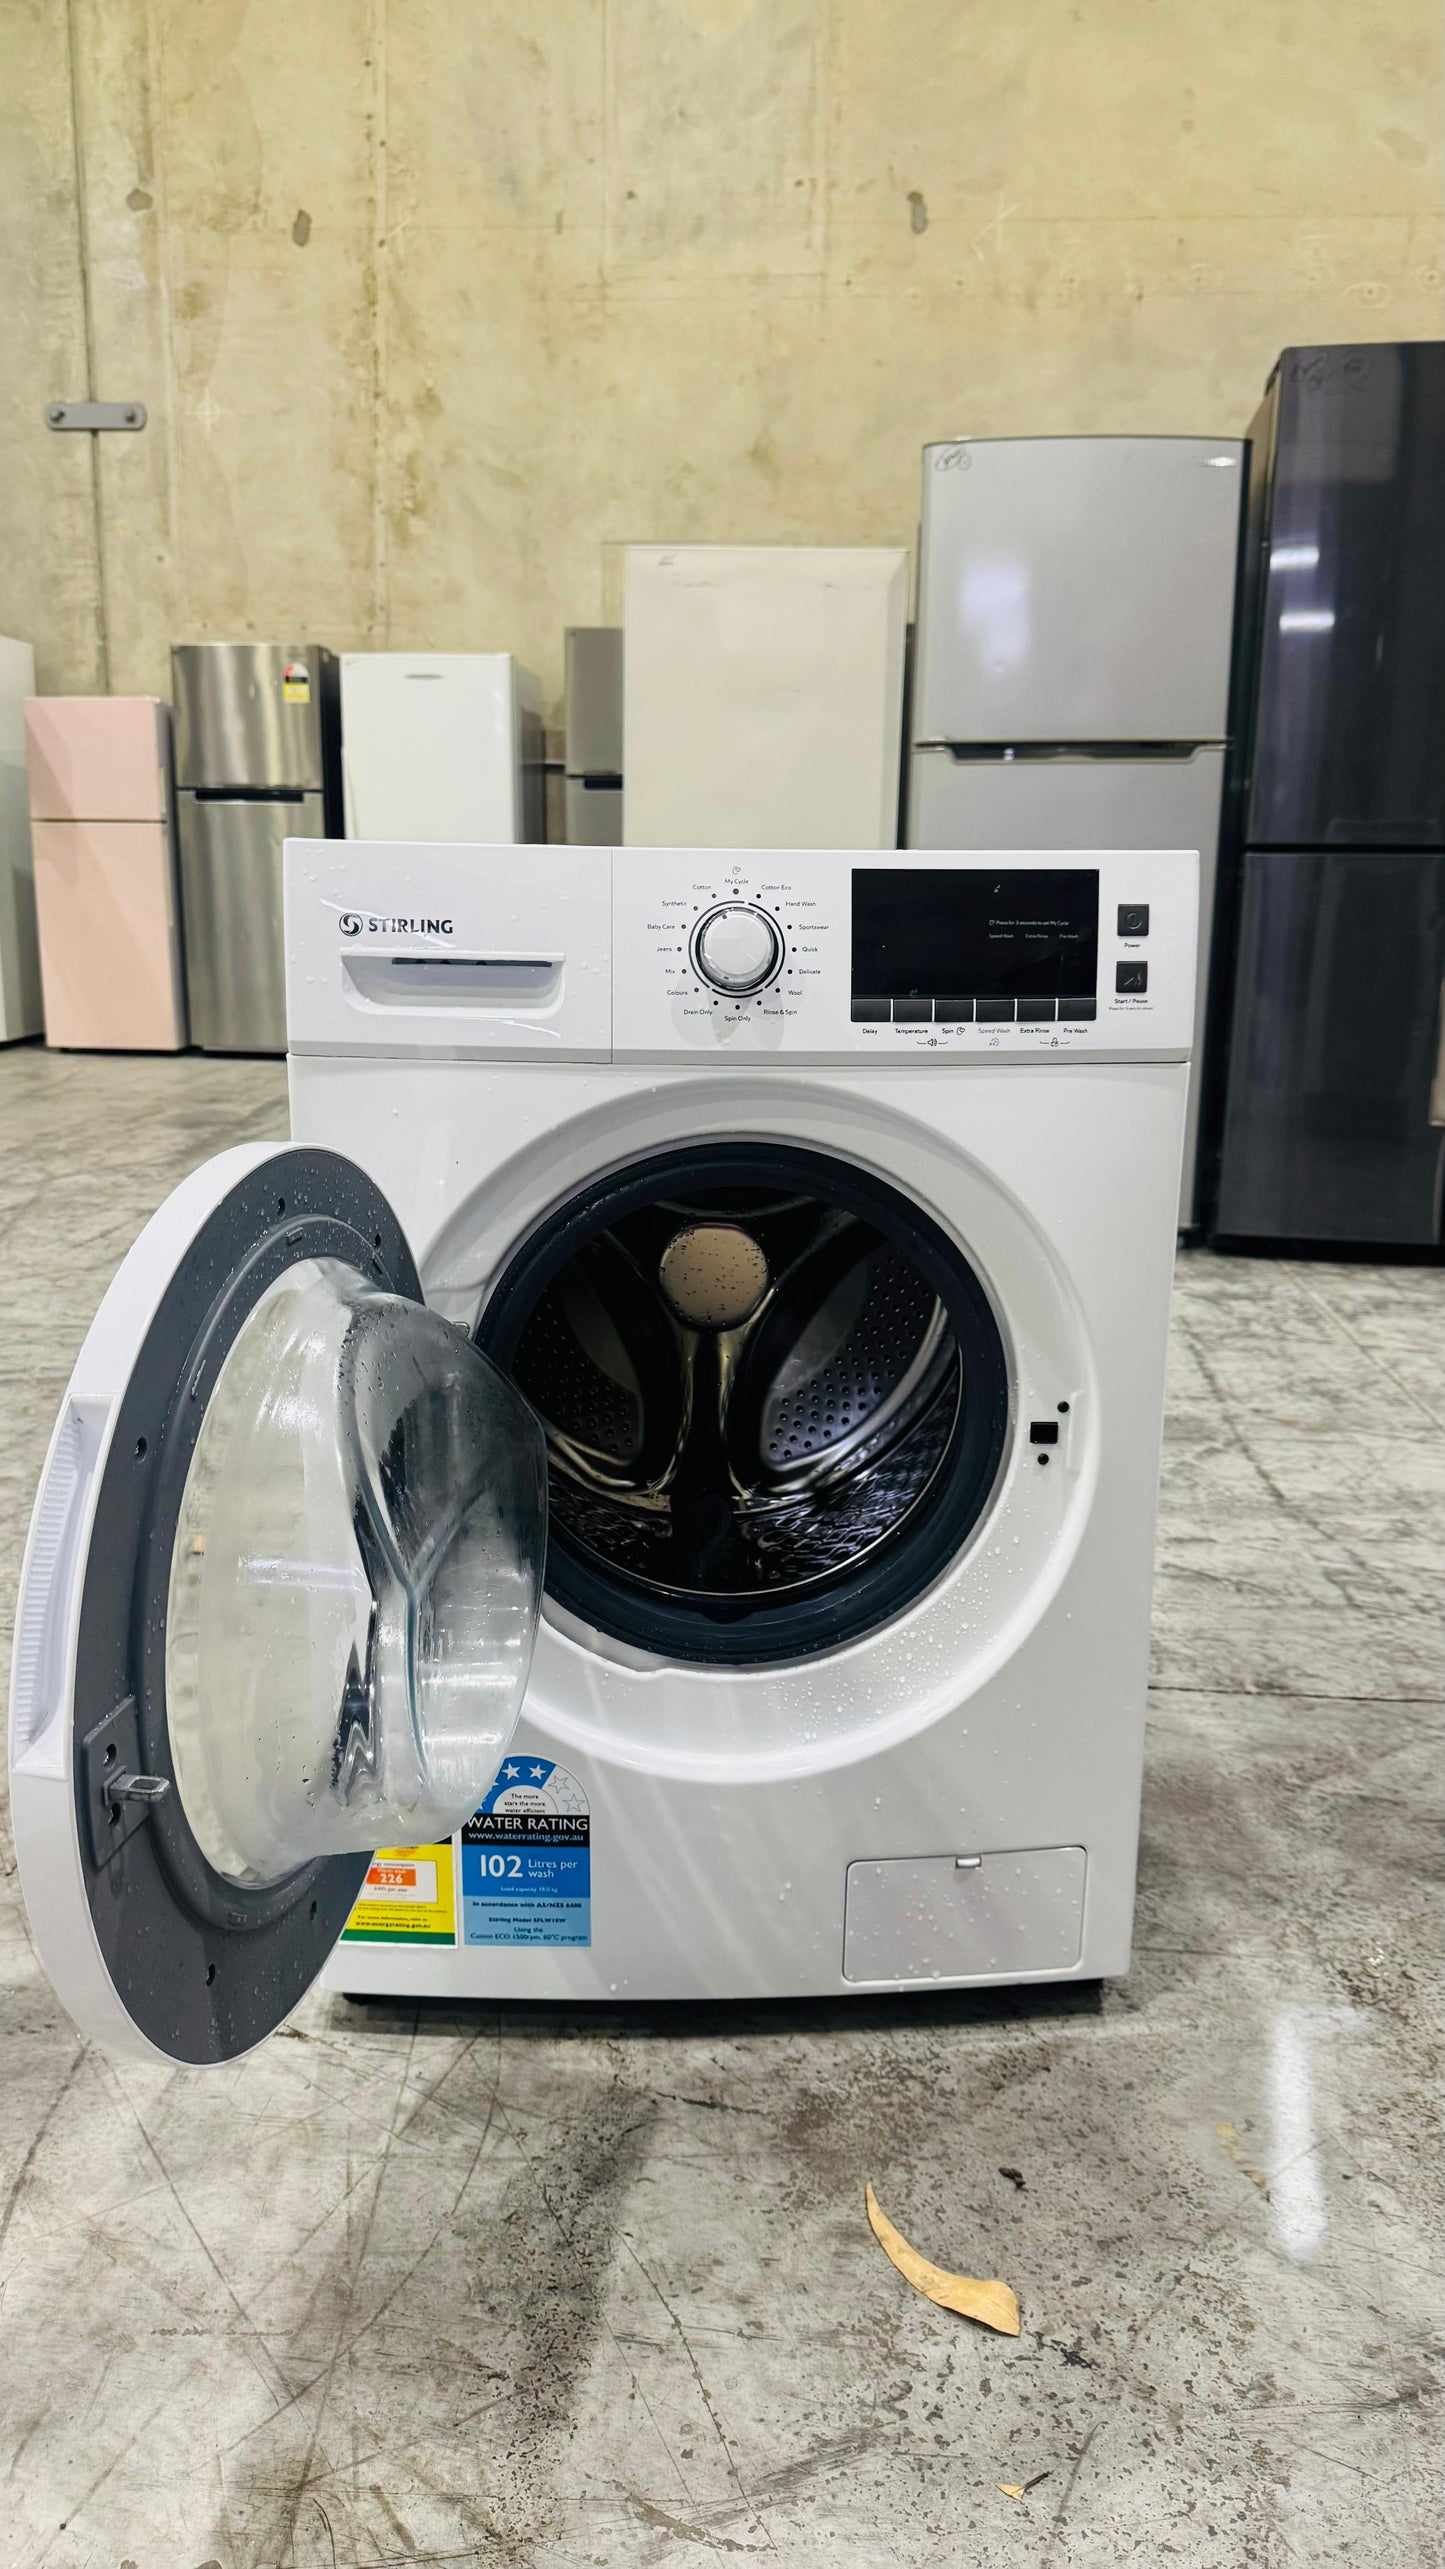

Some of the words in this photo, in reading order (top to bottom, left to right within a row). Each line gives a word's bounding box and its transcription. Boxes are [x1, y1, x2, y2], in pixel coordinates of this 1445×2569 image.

[662, 900, 688, 908] Synthetic
[368, 918, 453, 934] STIRLING
[895, 1028, 928, 1036] Temperature
[942, 1028, 954, 1036] Spin
[978, 1028, 996, 1036] Speed
[467, 1817, 522, 1830] WATER
[528, 1818, 588, 1830] RATING
[468, 1832, 584, 1842] www.waterrating.gov.au
[480, 1854, 524, 1878] 102
[528, 1859, 558, 1868] Litres
[560, 1861, 578, 1870] per
[380, 1873, 403, 1884] 226
[528, 1870, 554, 1878] wash
